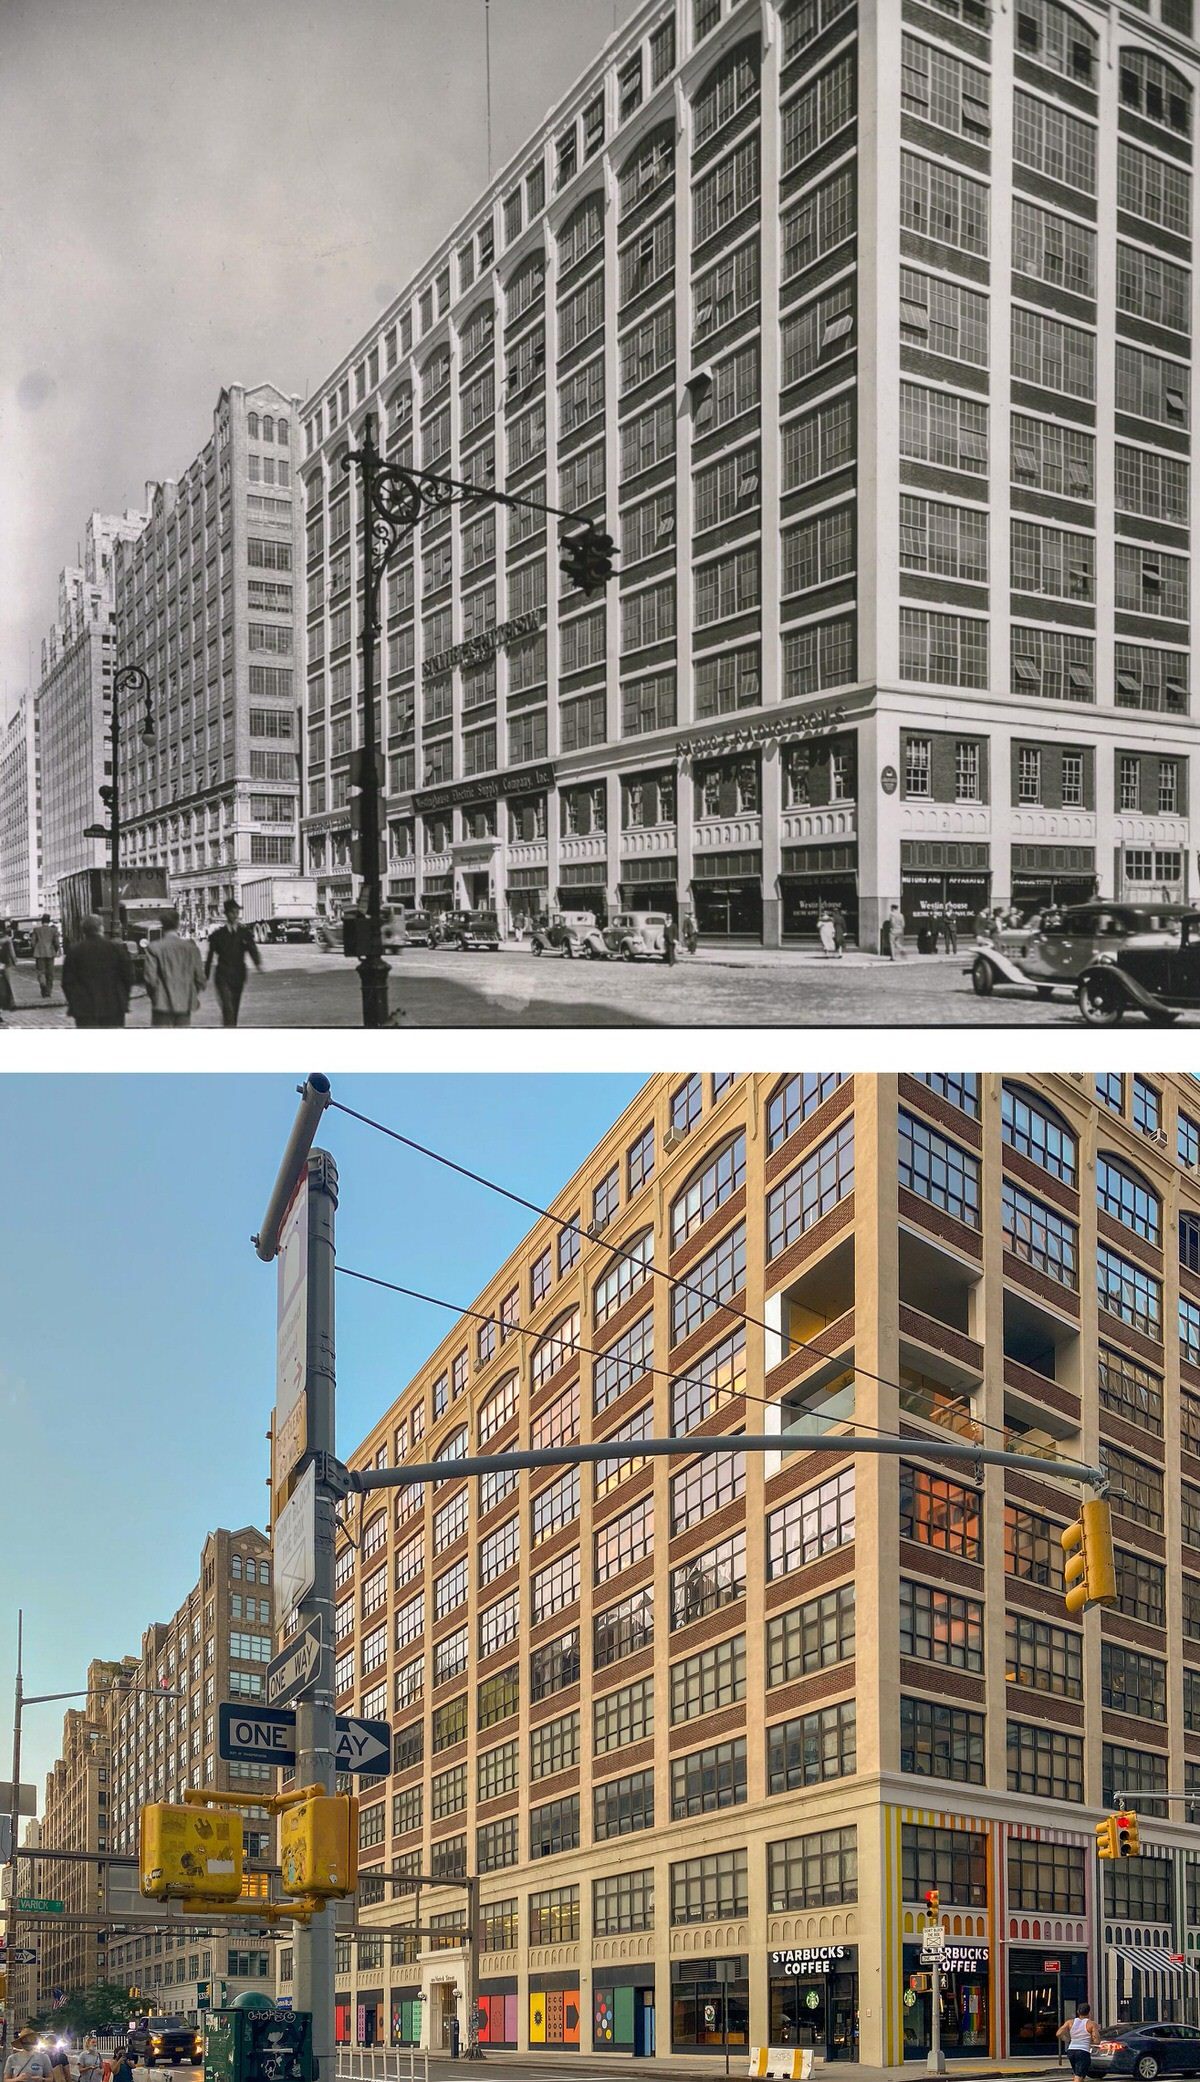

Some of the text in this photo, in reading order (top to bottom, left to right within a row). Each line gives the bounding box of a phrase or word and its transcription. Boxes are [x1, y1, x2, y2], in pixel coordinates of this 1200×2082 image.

[270, 1642, 313, 1698] ONE WAY
[235, 1721, 369, 1757] ONE AY
[20, 1900, 49, 1910] VARICK
[772, 1946, 844, 1963] STARBUCKS
[785, 1960, 830, 1975] COFFEE
[938, 1960, 977, 1973] OFFEE
